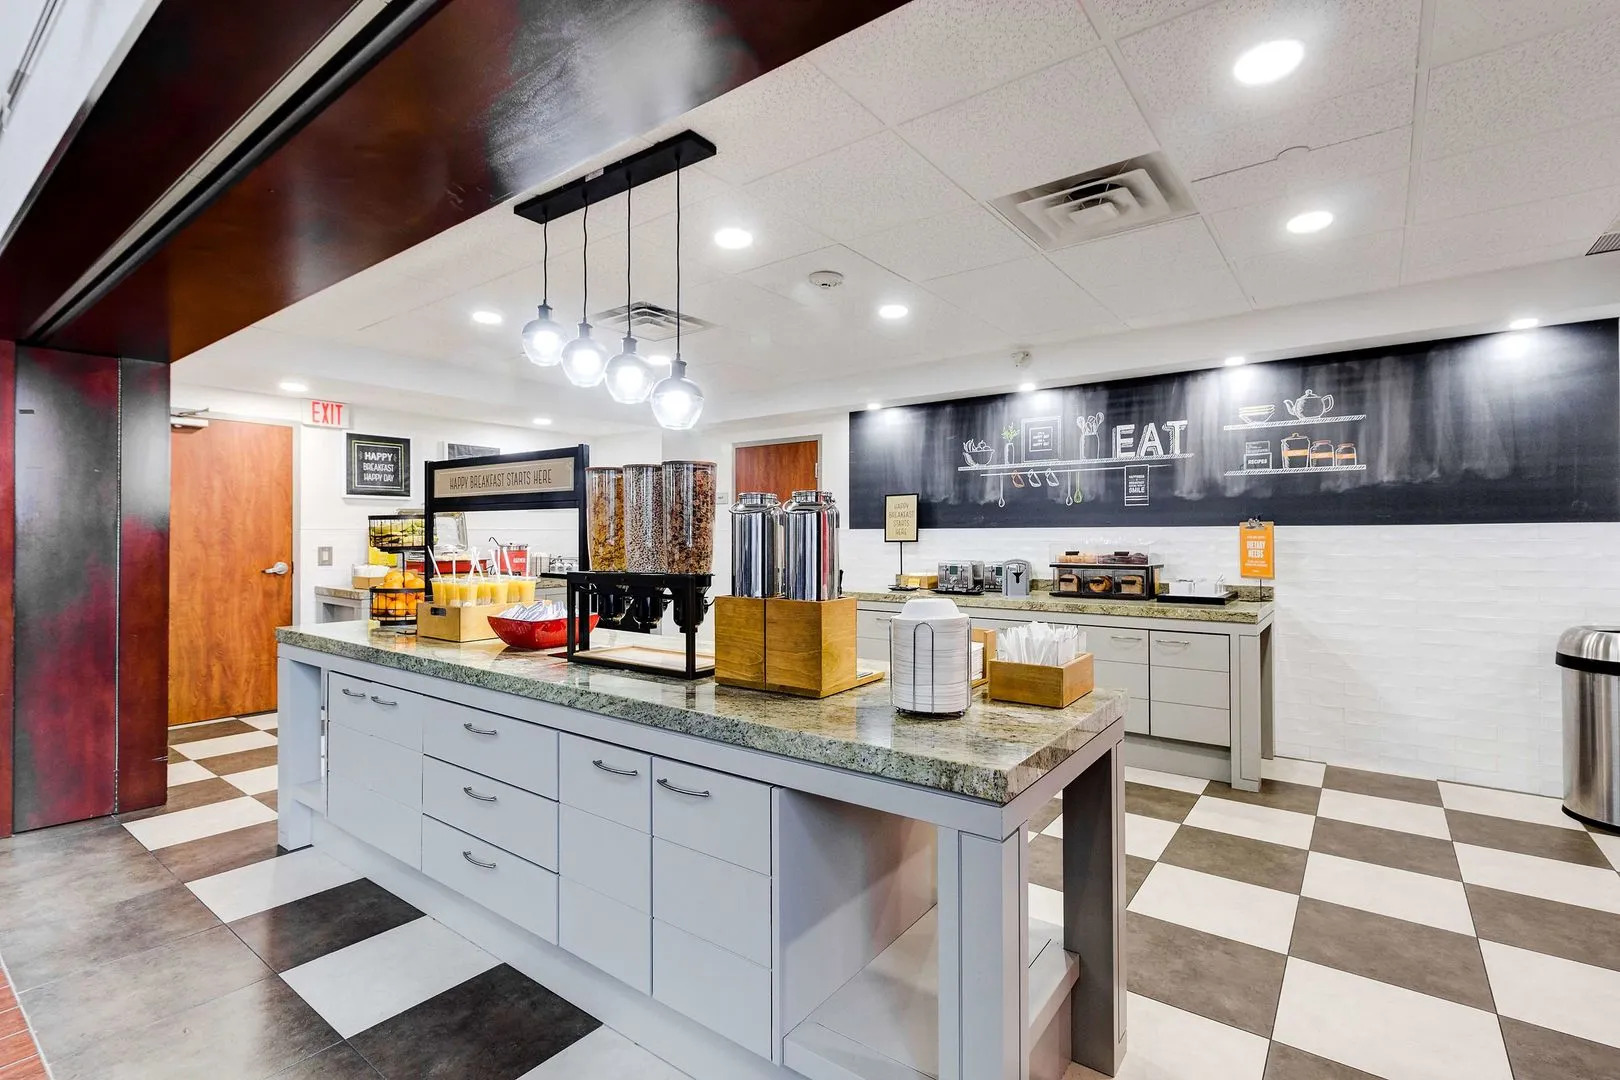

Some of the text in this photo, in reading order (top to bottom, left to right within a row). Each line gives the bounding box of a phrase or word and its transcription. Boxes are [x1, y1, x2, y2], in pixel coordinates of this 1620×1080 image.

[311, 401, 343, 425] EXIT
[1112, 420, 1188, 458] EAT
[364, 451, 393, 462] HAPPY
[362, 462, 395, 473] BREAKFAST
[363, 473, 395, 483] HAPPY DAY
[449, 468, 552, 490] HAPPY BREAKFAST STARTS HERE
[893, 502, 910, 510] HAPPY
[888, 510, 914, 519] BREAKFAST
[892, 519, 911, 527] STARTS
[895, 528, 907, 536] HERE
[1246, 540, 1266, 550] DIETARY
[1247, 549, 1264, 559] NEEDS
